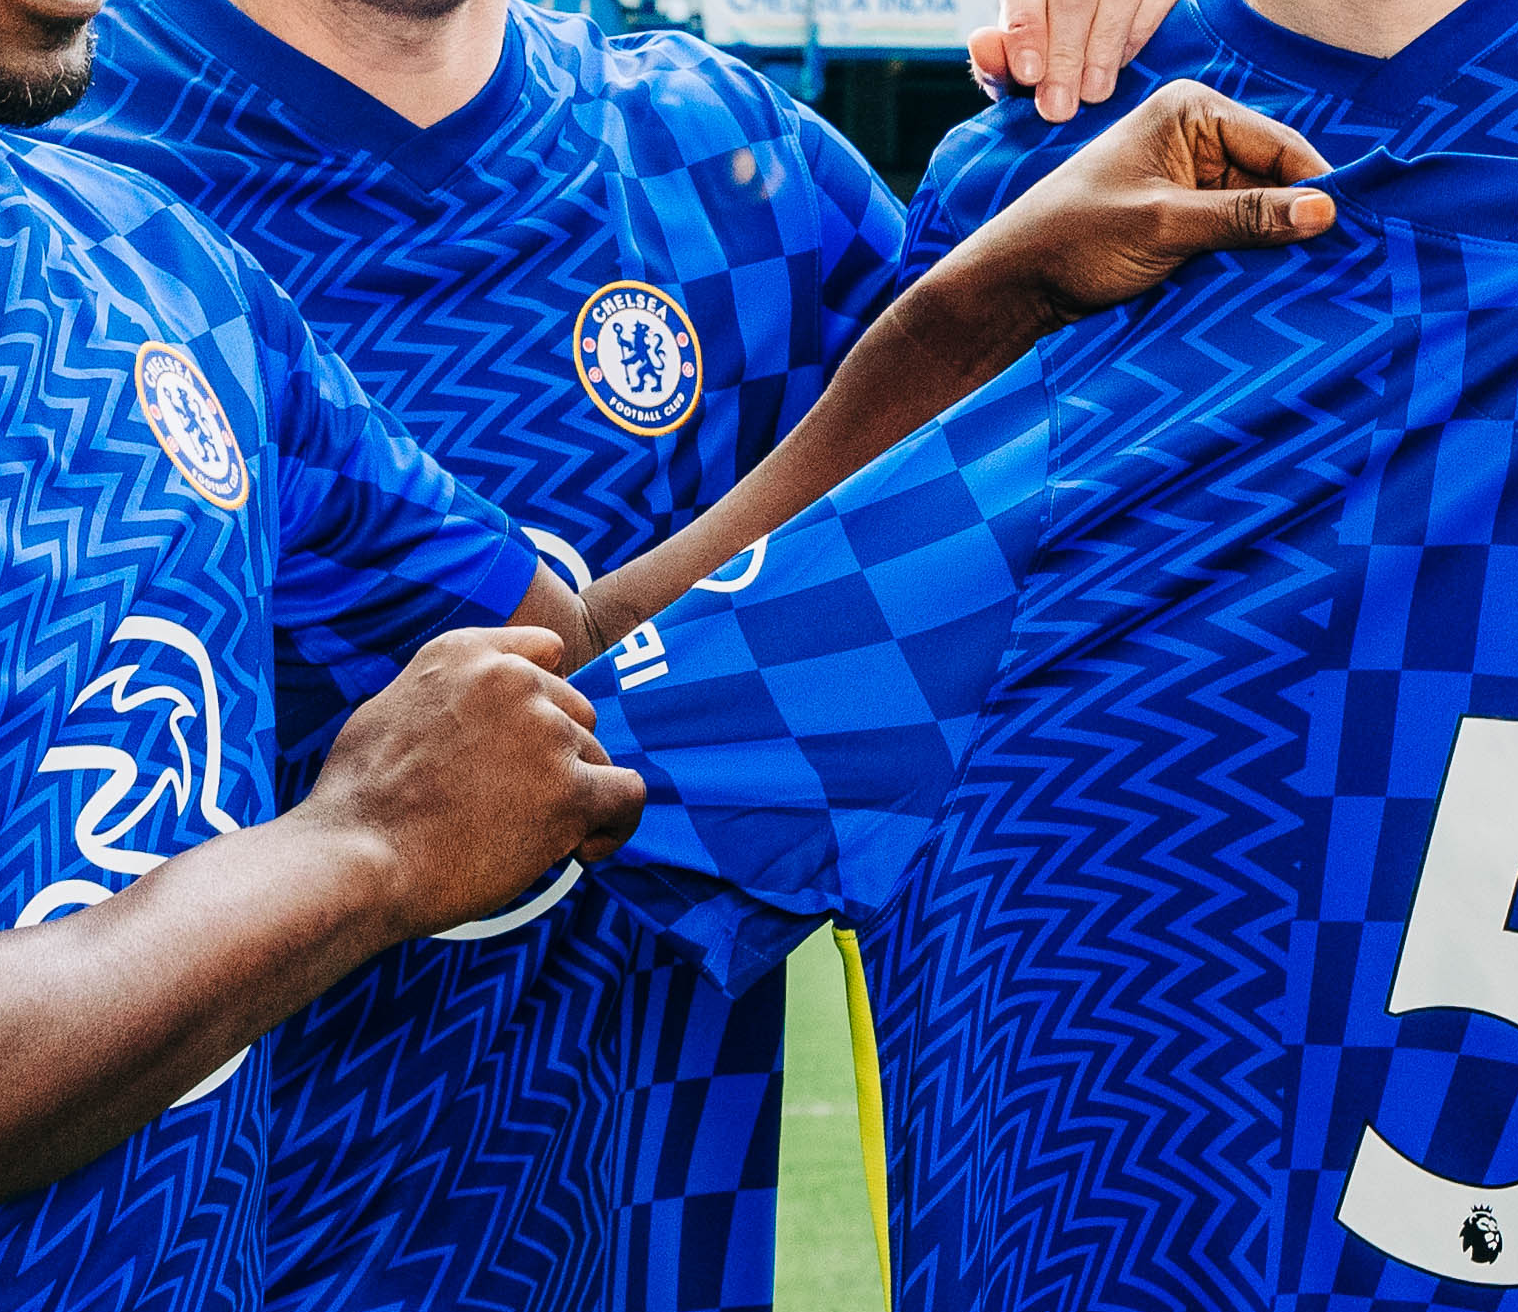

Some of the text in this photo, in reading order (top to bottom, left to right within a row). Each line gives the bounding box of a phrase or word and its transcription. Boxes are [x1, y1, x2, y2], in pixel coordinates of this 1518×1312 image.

[592, 293, 668, 324] CHELSEA
[144, 355, 195, 389] CHELSEA
[609, 396, 662, 422] FOOTBALL
